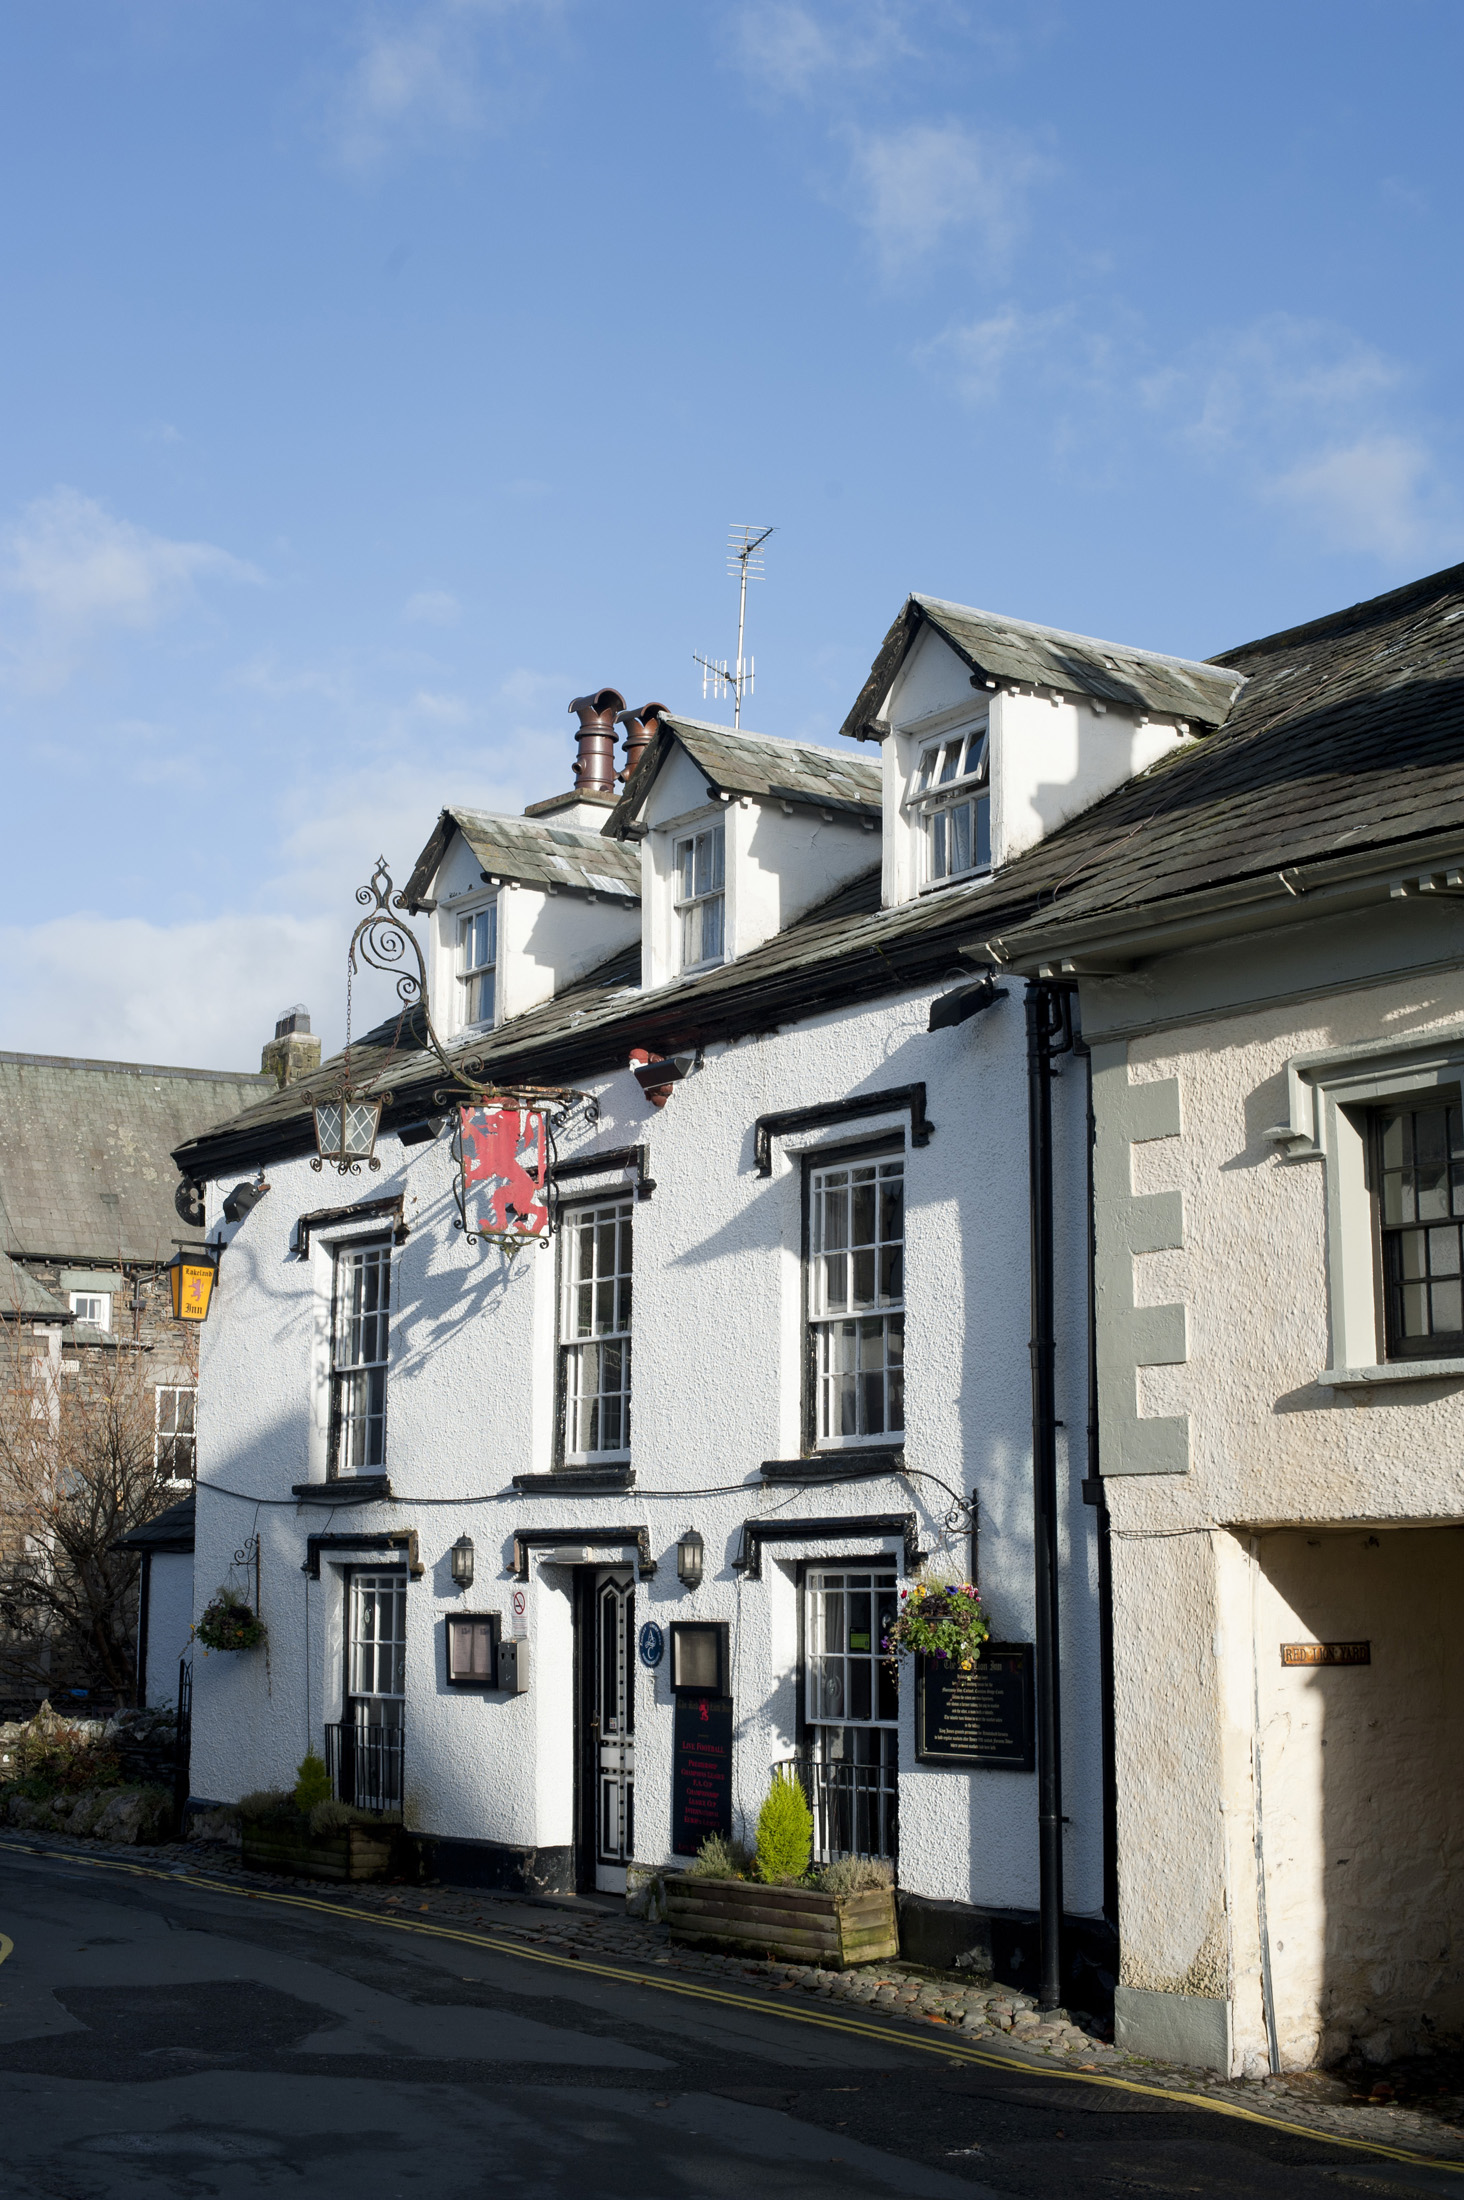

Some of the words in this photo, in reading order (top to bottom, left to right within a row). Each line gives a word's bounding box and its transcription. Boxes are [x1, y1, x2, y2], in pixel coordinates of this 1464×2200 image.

[185, 1268, 213, 1277] Lakeland
[184, 1303, 203, 1314] Inn
[1286, 1648, 1306, 1662] RED
[1313, 1647, 1335, 1661] LION
[1340, 1647, 1366, 1660] YARD
[681, 1741, 695, 1750] LIVE
[696, 1742, 725, 1753] FOOTBALL
